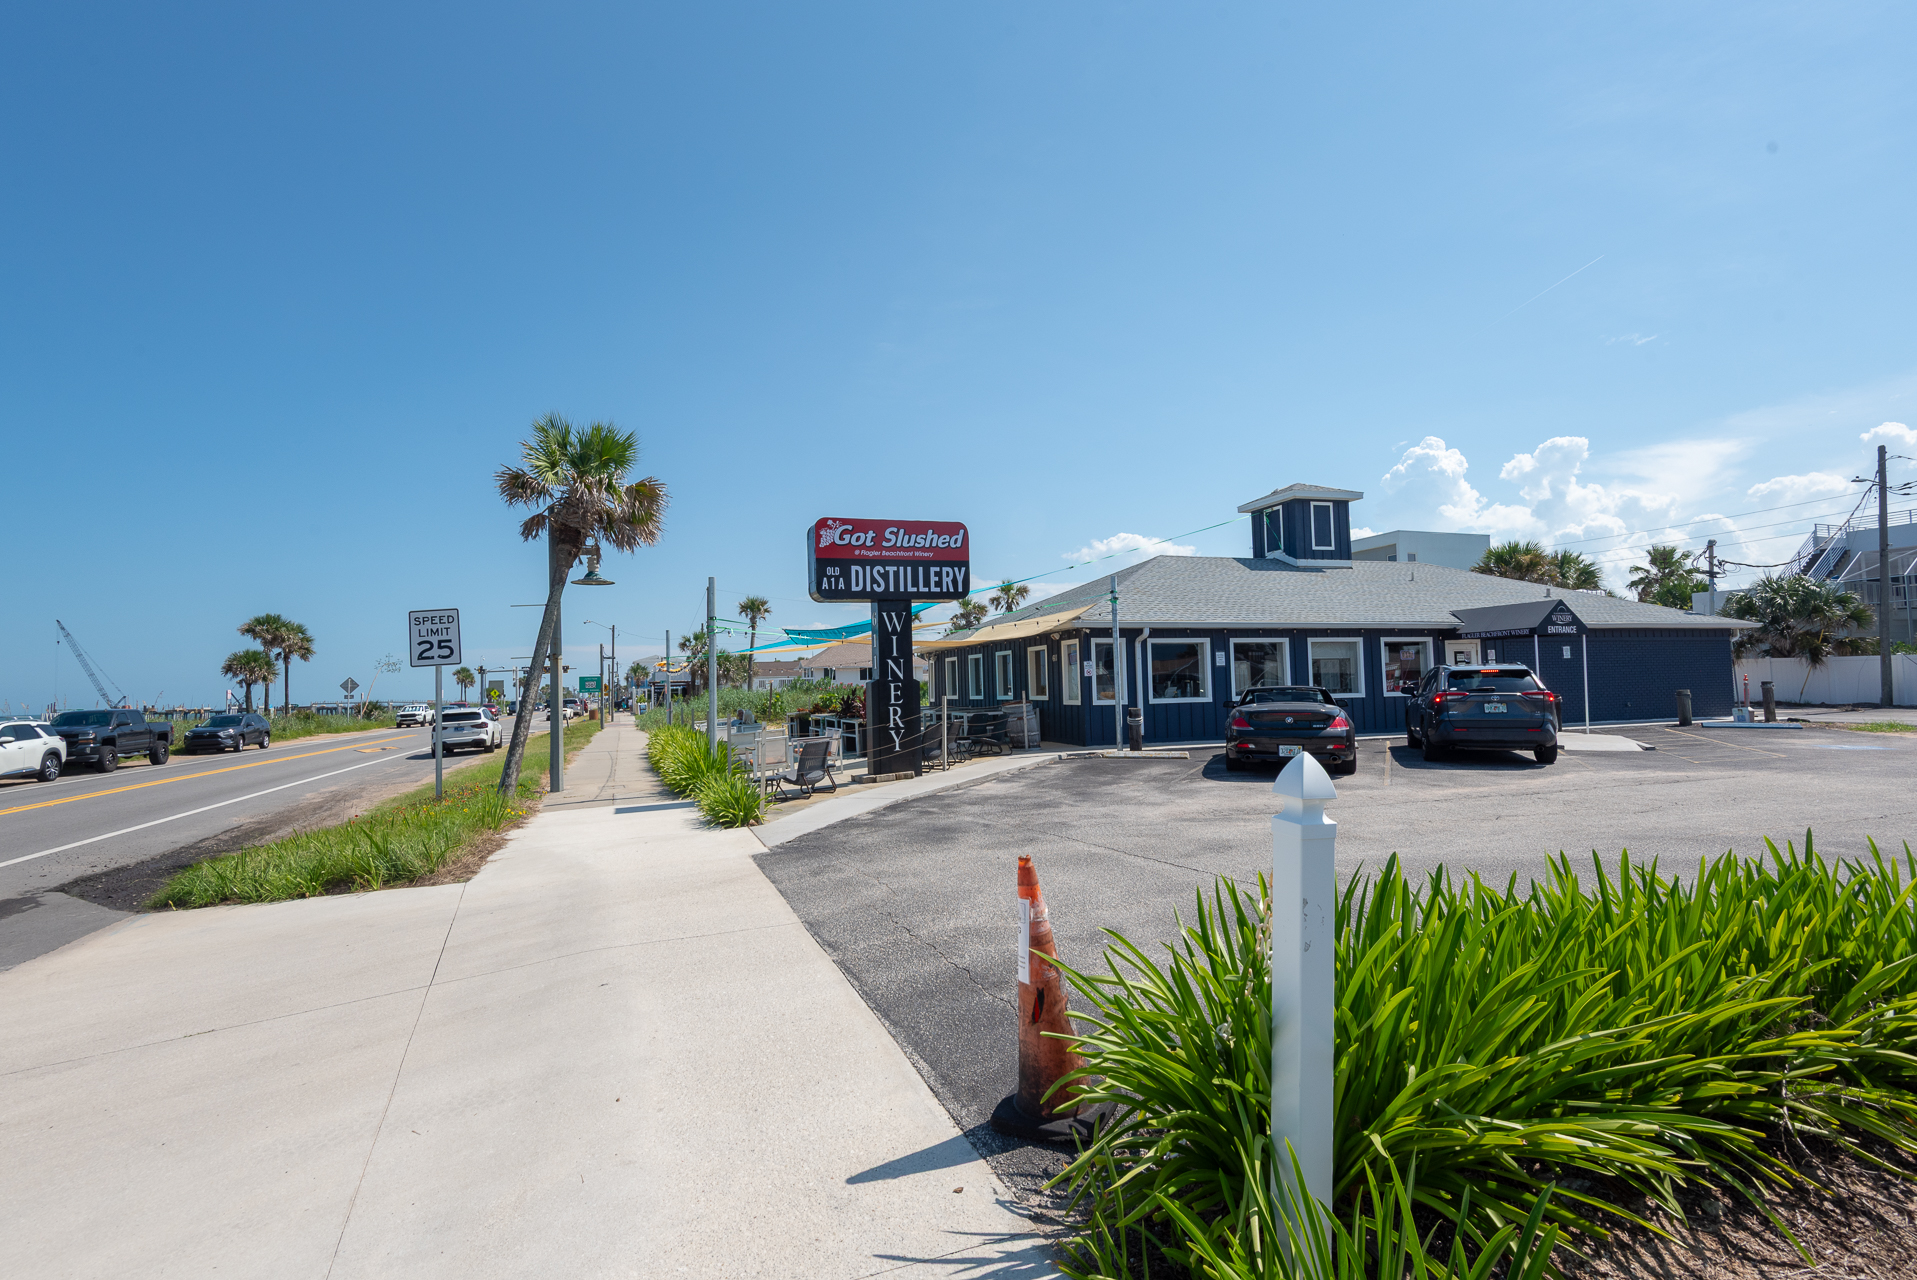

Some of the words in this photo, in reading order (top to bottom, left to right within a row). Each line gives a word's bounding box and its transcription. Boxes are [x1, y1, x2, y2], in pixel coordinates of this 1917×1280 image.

[834, 525, 876, 547] Got
[882, 527, 965, 549] Slushed
[861, 549, 881, 557] Flagler
[826, 566, 840, 576] OLD
[851, 565, 966, 593] DISTILLERY
[414, 615, 454, 626] SPEED
[1551, 614, 1573, 622] WINERY
[418, 627, 450, 637] LIMIT
[1480, 630, 1510, 638] BEACHFRONT
[1510, 628, 1530, 636] WINERY
[1547, 625, 1577, 634] ENTRANCE
[417, 639, 454, 660] 25
[881, 611, 907, 752] WINERY
